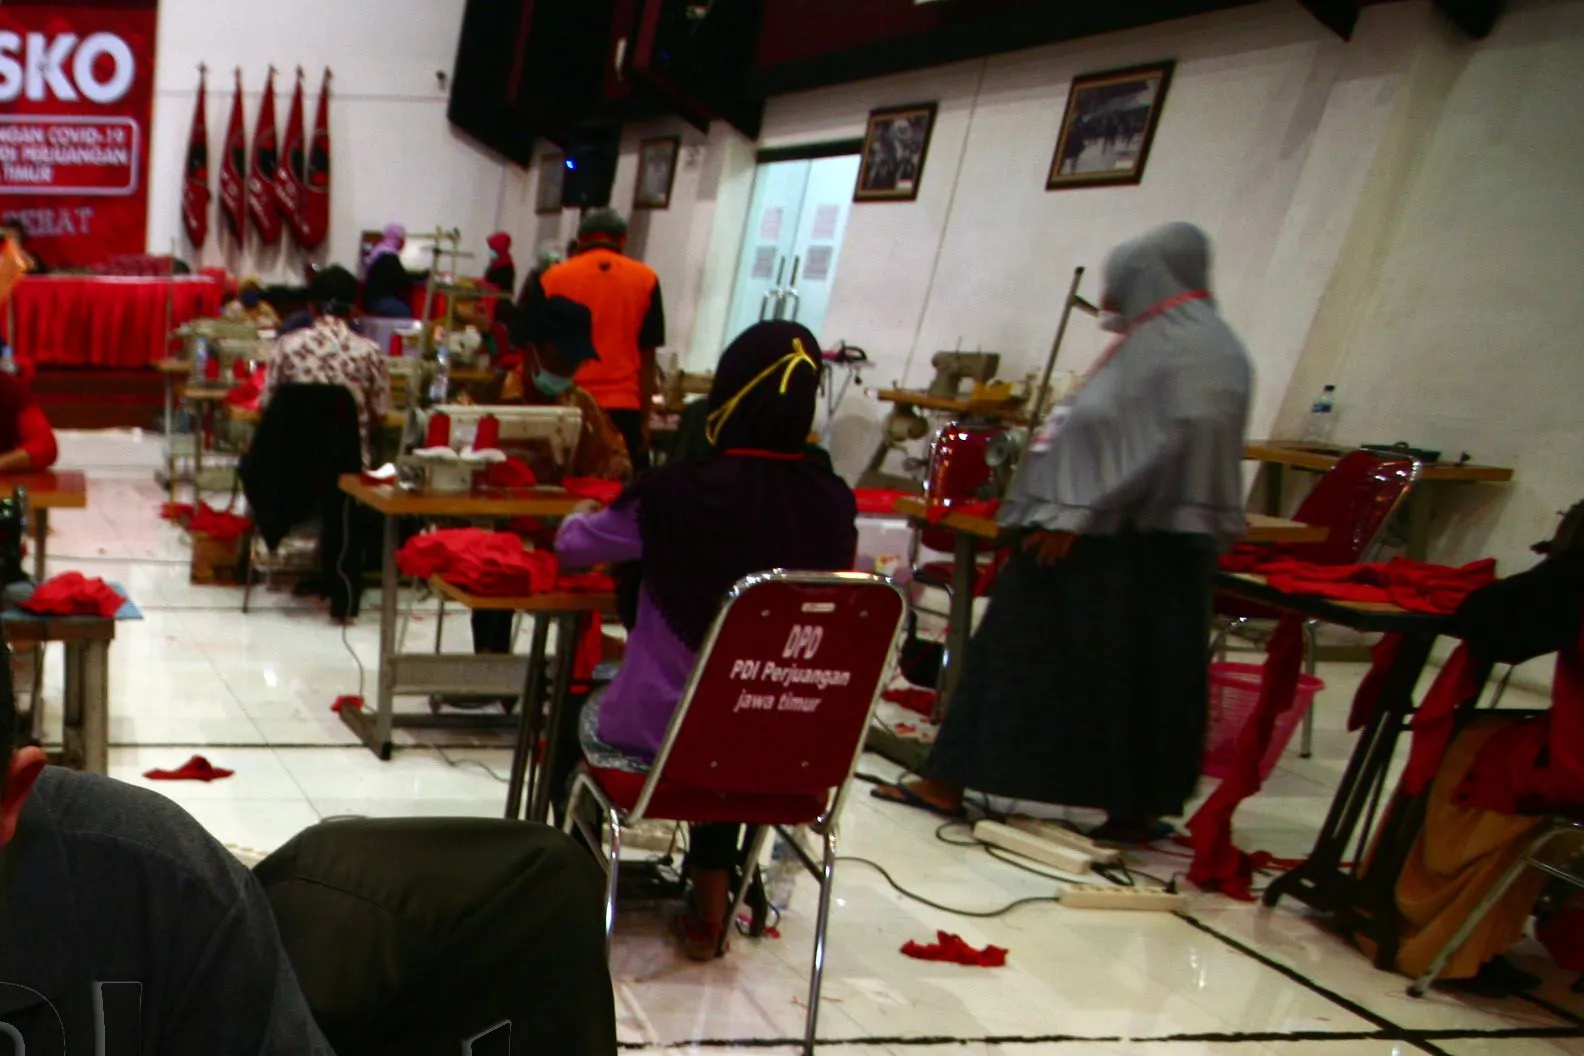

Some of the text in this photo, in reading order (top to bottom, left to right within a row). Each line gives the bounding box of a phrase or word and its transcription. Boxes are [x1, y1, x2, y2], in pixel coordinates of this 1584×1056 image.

[3, 165, 54, 182] TIMUR
[782, 624, 824, 659] DPD
[730, 659, 851, 689] PDI Perjuangan
[777, 691, 821, 712] timur
